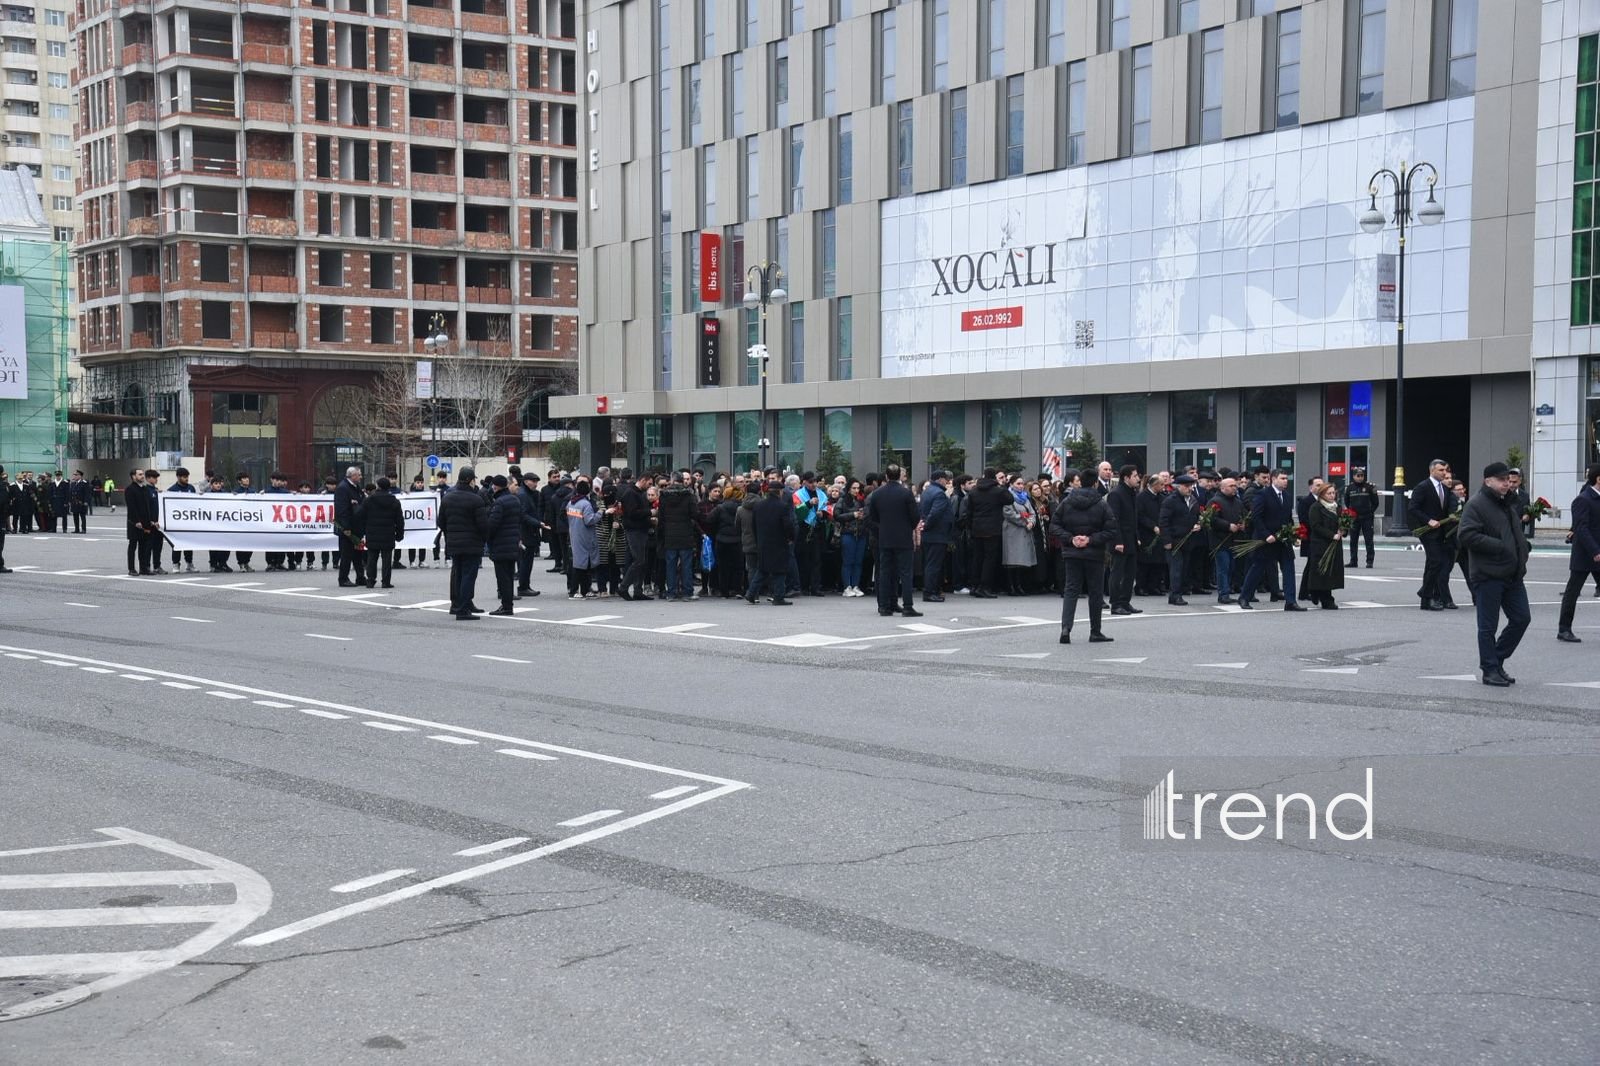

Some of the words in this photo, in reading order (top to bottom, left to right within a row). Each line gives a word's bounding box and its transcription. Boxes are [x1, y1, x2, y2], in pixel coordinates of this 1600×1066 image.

[587, 29, 600, 210] HOTEL
[931, 243, 1057, 297] XOCALI
[708, 271, 717, 290] ibis
[972, 312, 1012, 326] 26.02.1992
[705, 323, 716, 331] ibis
[1330, 407, 1345, 415] AVIS
[1353, 404, 1369, 412] Budget
